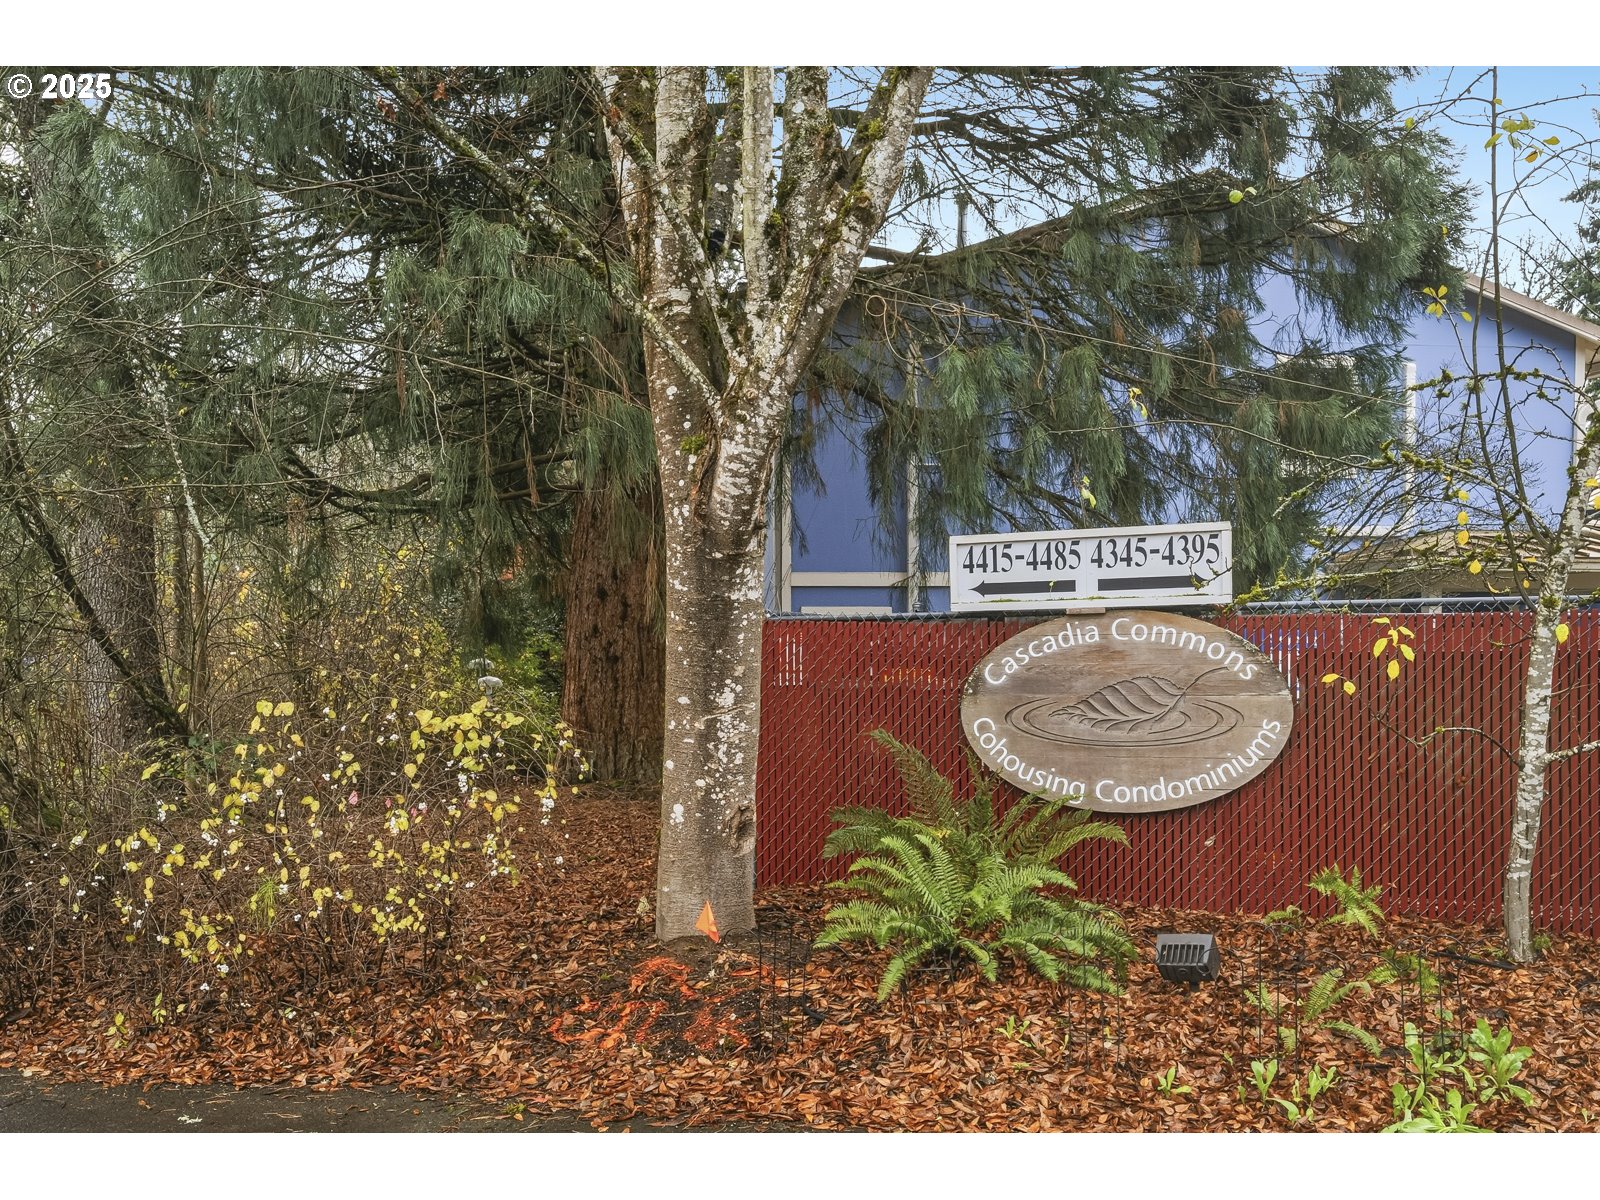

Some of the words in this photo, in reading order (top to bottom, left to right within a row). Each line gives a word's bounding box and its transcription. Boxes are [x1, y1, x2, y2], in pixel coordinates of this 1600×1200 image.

[962, 539, 1081, 574] 4415-4485
[1090, 533, 1220, 569] 4345-4395
[983, 622, 1100, 685] Cascadia
[1111, 617, 1258, 680] Commons
[973, 717, 1086, 804] Cohousing
[1095, 718, 1281, 804] Condominiums
